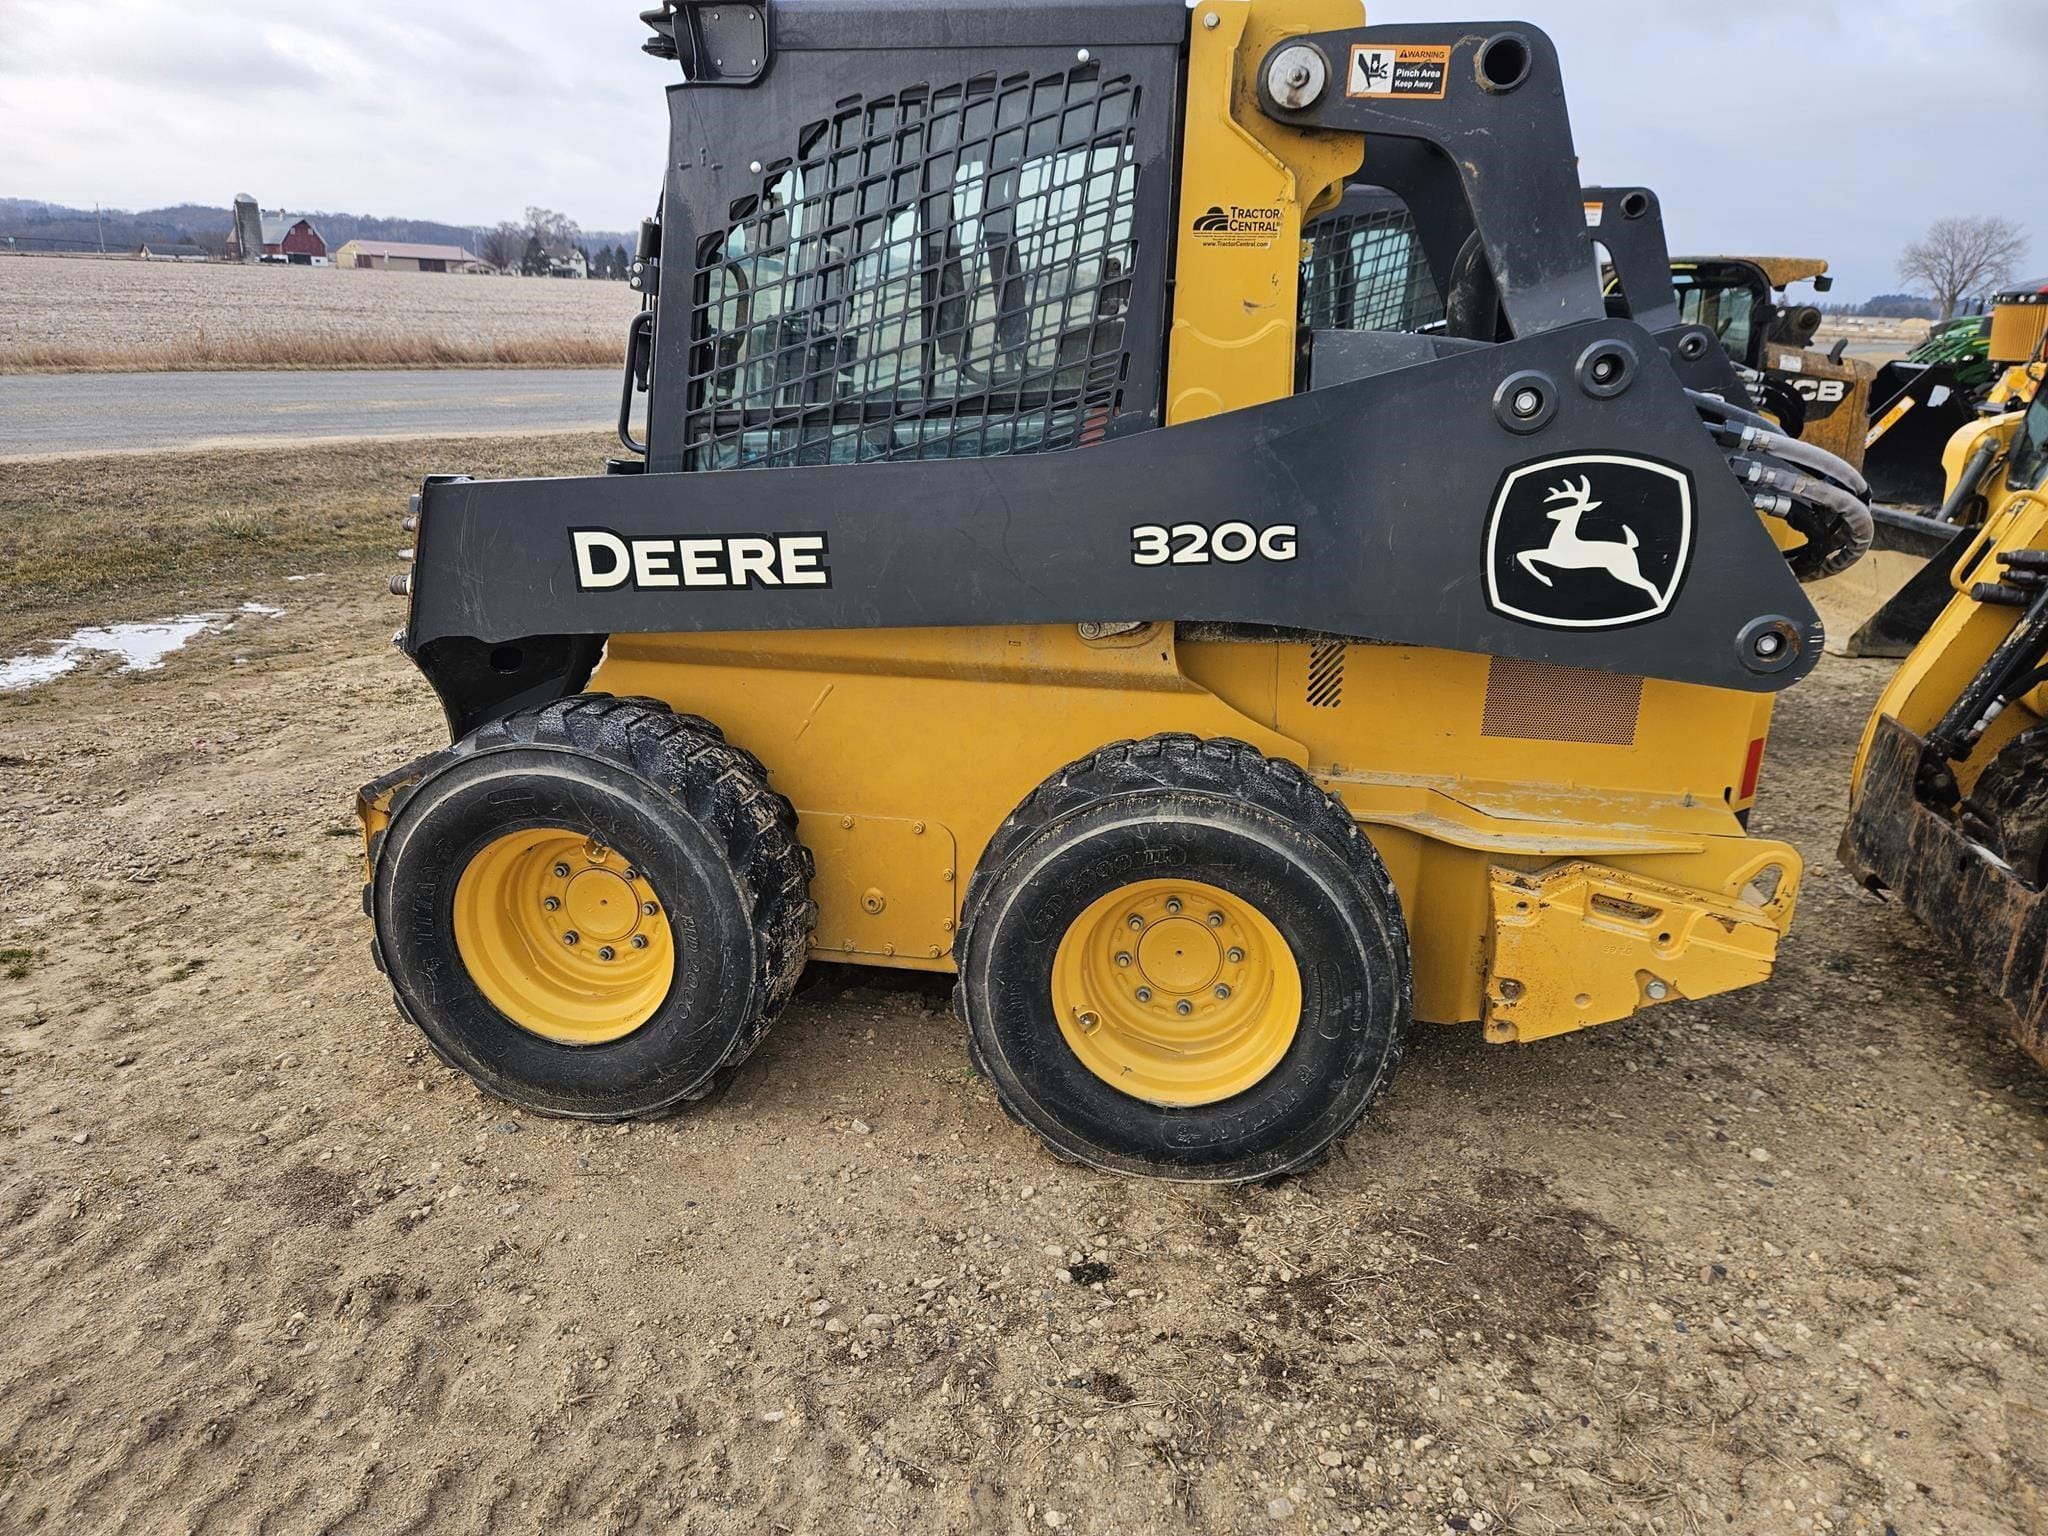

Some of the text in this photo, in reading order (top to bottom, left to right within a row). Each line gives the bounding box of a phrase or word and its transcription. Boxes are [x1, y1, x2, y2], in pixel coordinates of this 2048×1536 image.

[1407, 50, 1445, 59] WARNING
[1396, 68, 1441, 78] Pinch Area
[1394, 80, 1434, 90] Keep Away
[1230, 206, 1280, 219] TRACTOR
[1229, 219, 1278, 232] CENTRAL
[1785, 379, 1845, 402] CB
[1131, 520, 1298, 566] 320G
[571, 530, 829, 590] DEERE
